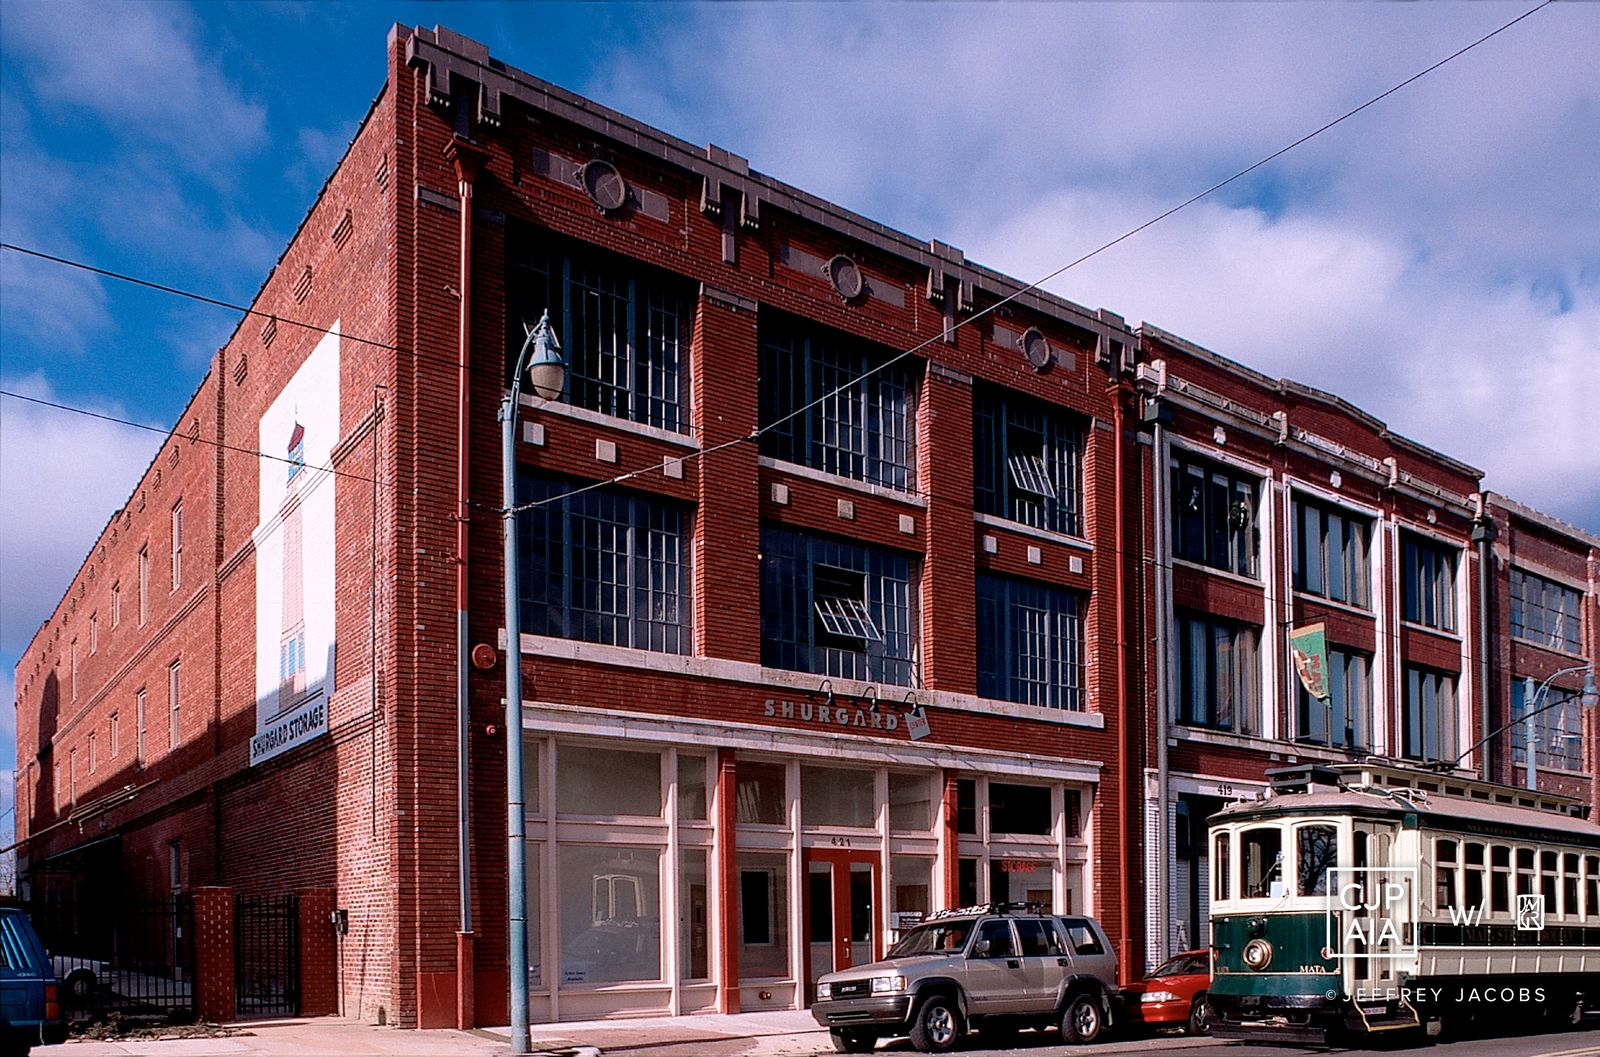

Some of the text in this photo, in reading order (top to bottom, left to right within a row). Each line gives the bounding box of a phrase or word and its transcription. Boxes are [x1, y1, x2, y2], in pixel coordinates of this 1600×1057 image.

[764, 699, 898, 731] SHURGARD
[252, 704, 324, 758] SHURGARD STORAGE
[1217, 784, 1233, 796] 419
[830, 836, 851, 847] 421
[1299, 965, 1326, 973] MATA
